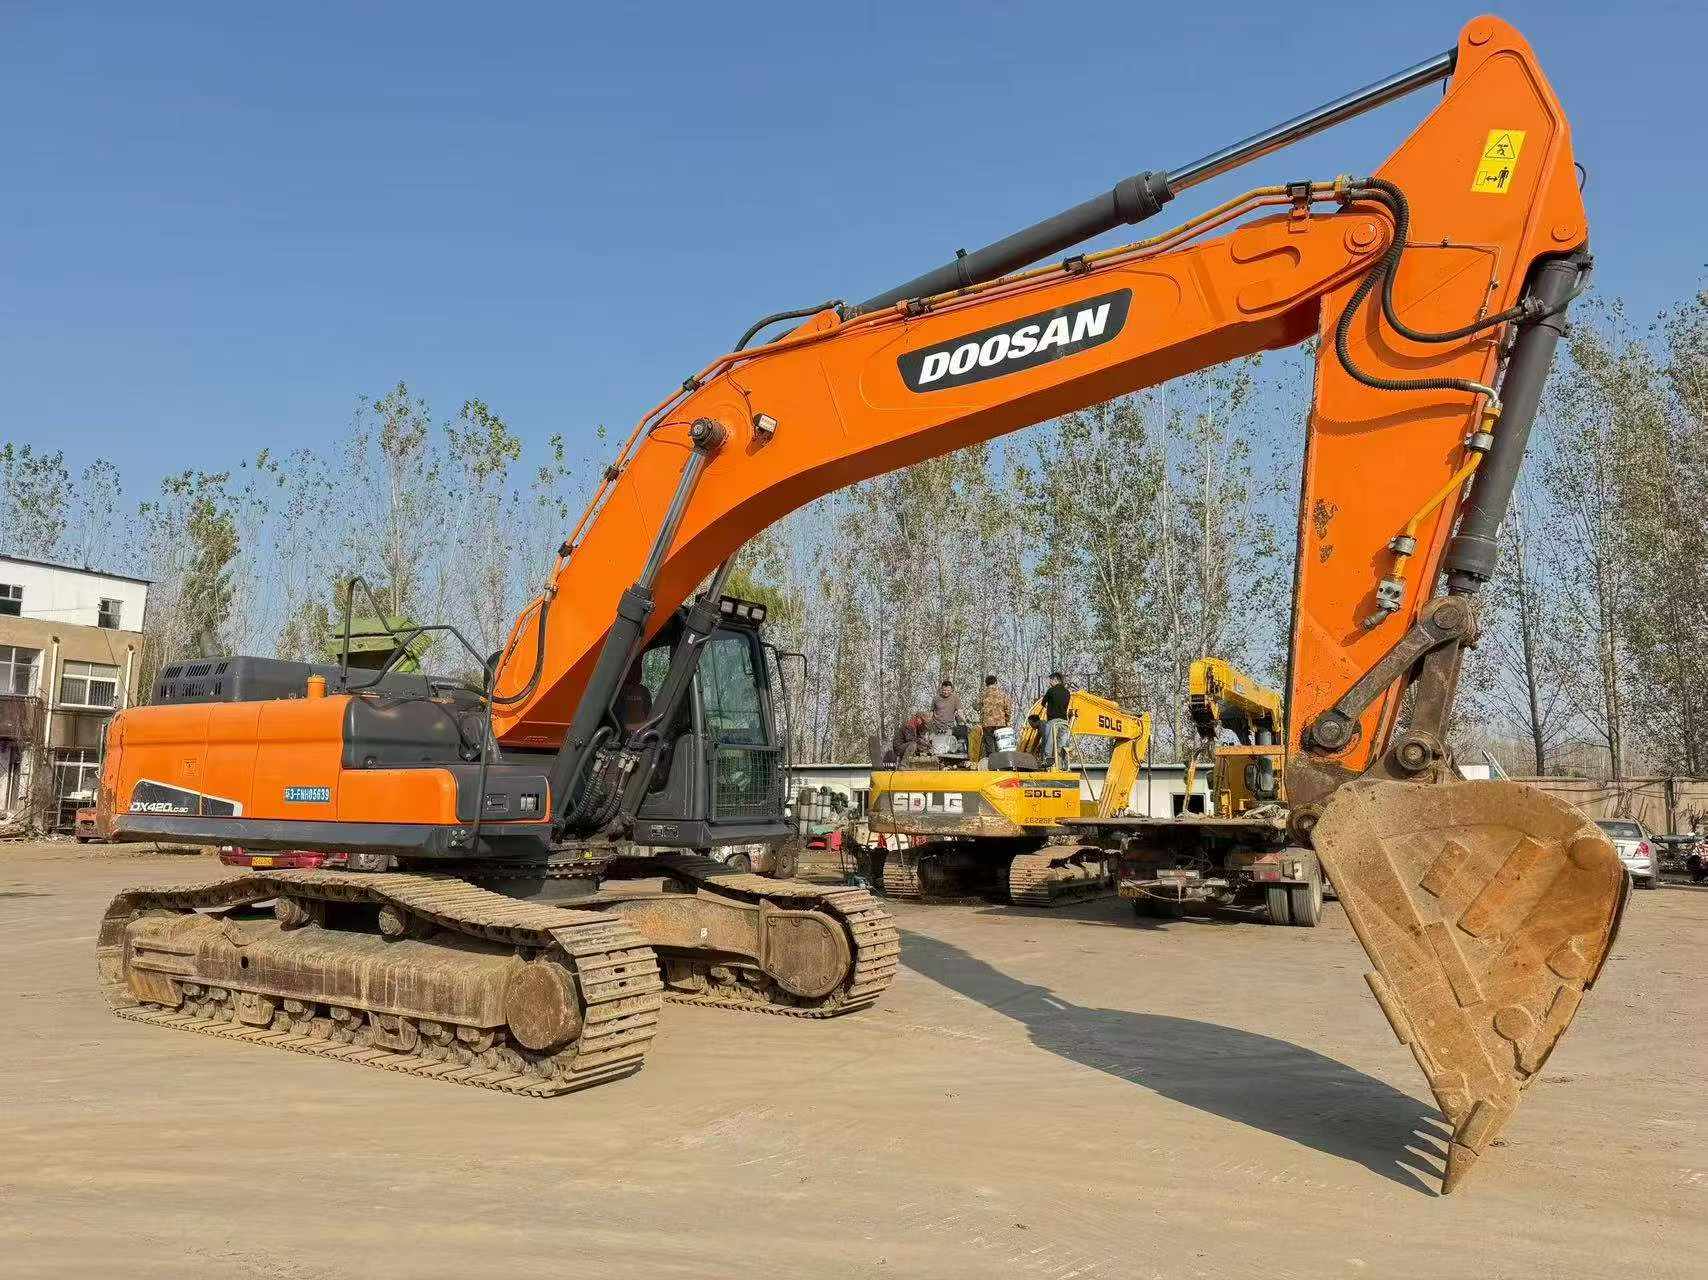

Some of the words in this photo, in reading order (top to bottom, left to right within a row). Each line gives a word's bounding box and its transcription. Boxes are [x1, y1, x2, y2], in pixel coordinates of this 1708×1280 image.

[918, 302, 1111, 385] DOOSAN
[1098, 714, 1122, 732] SDLG
[893, 792, 963, 813] SDLG
[1024, 789, 1062, 798] SDLG
